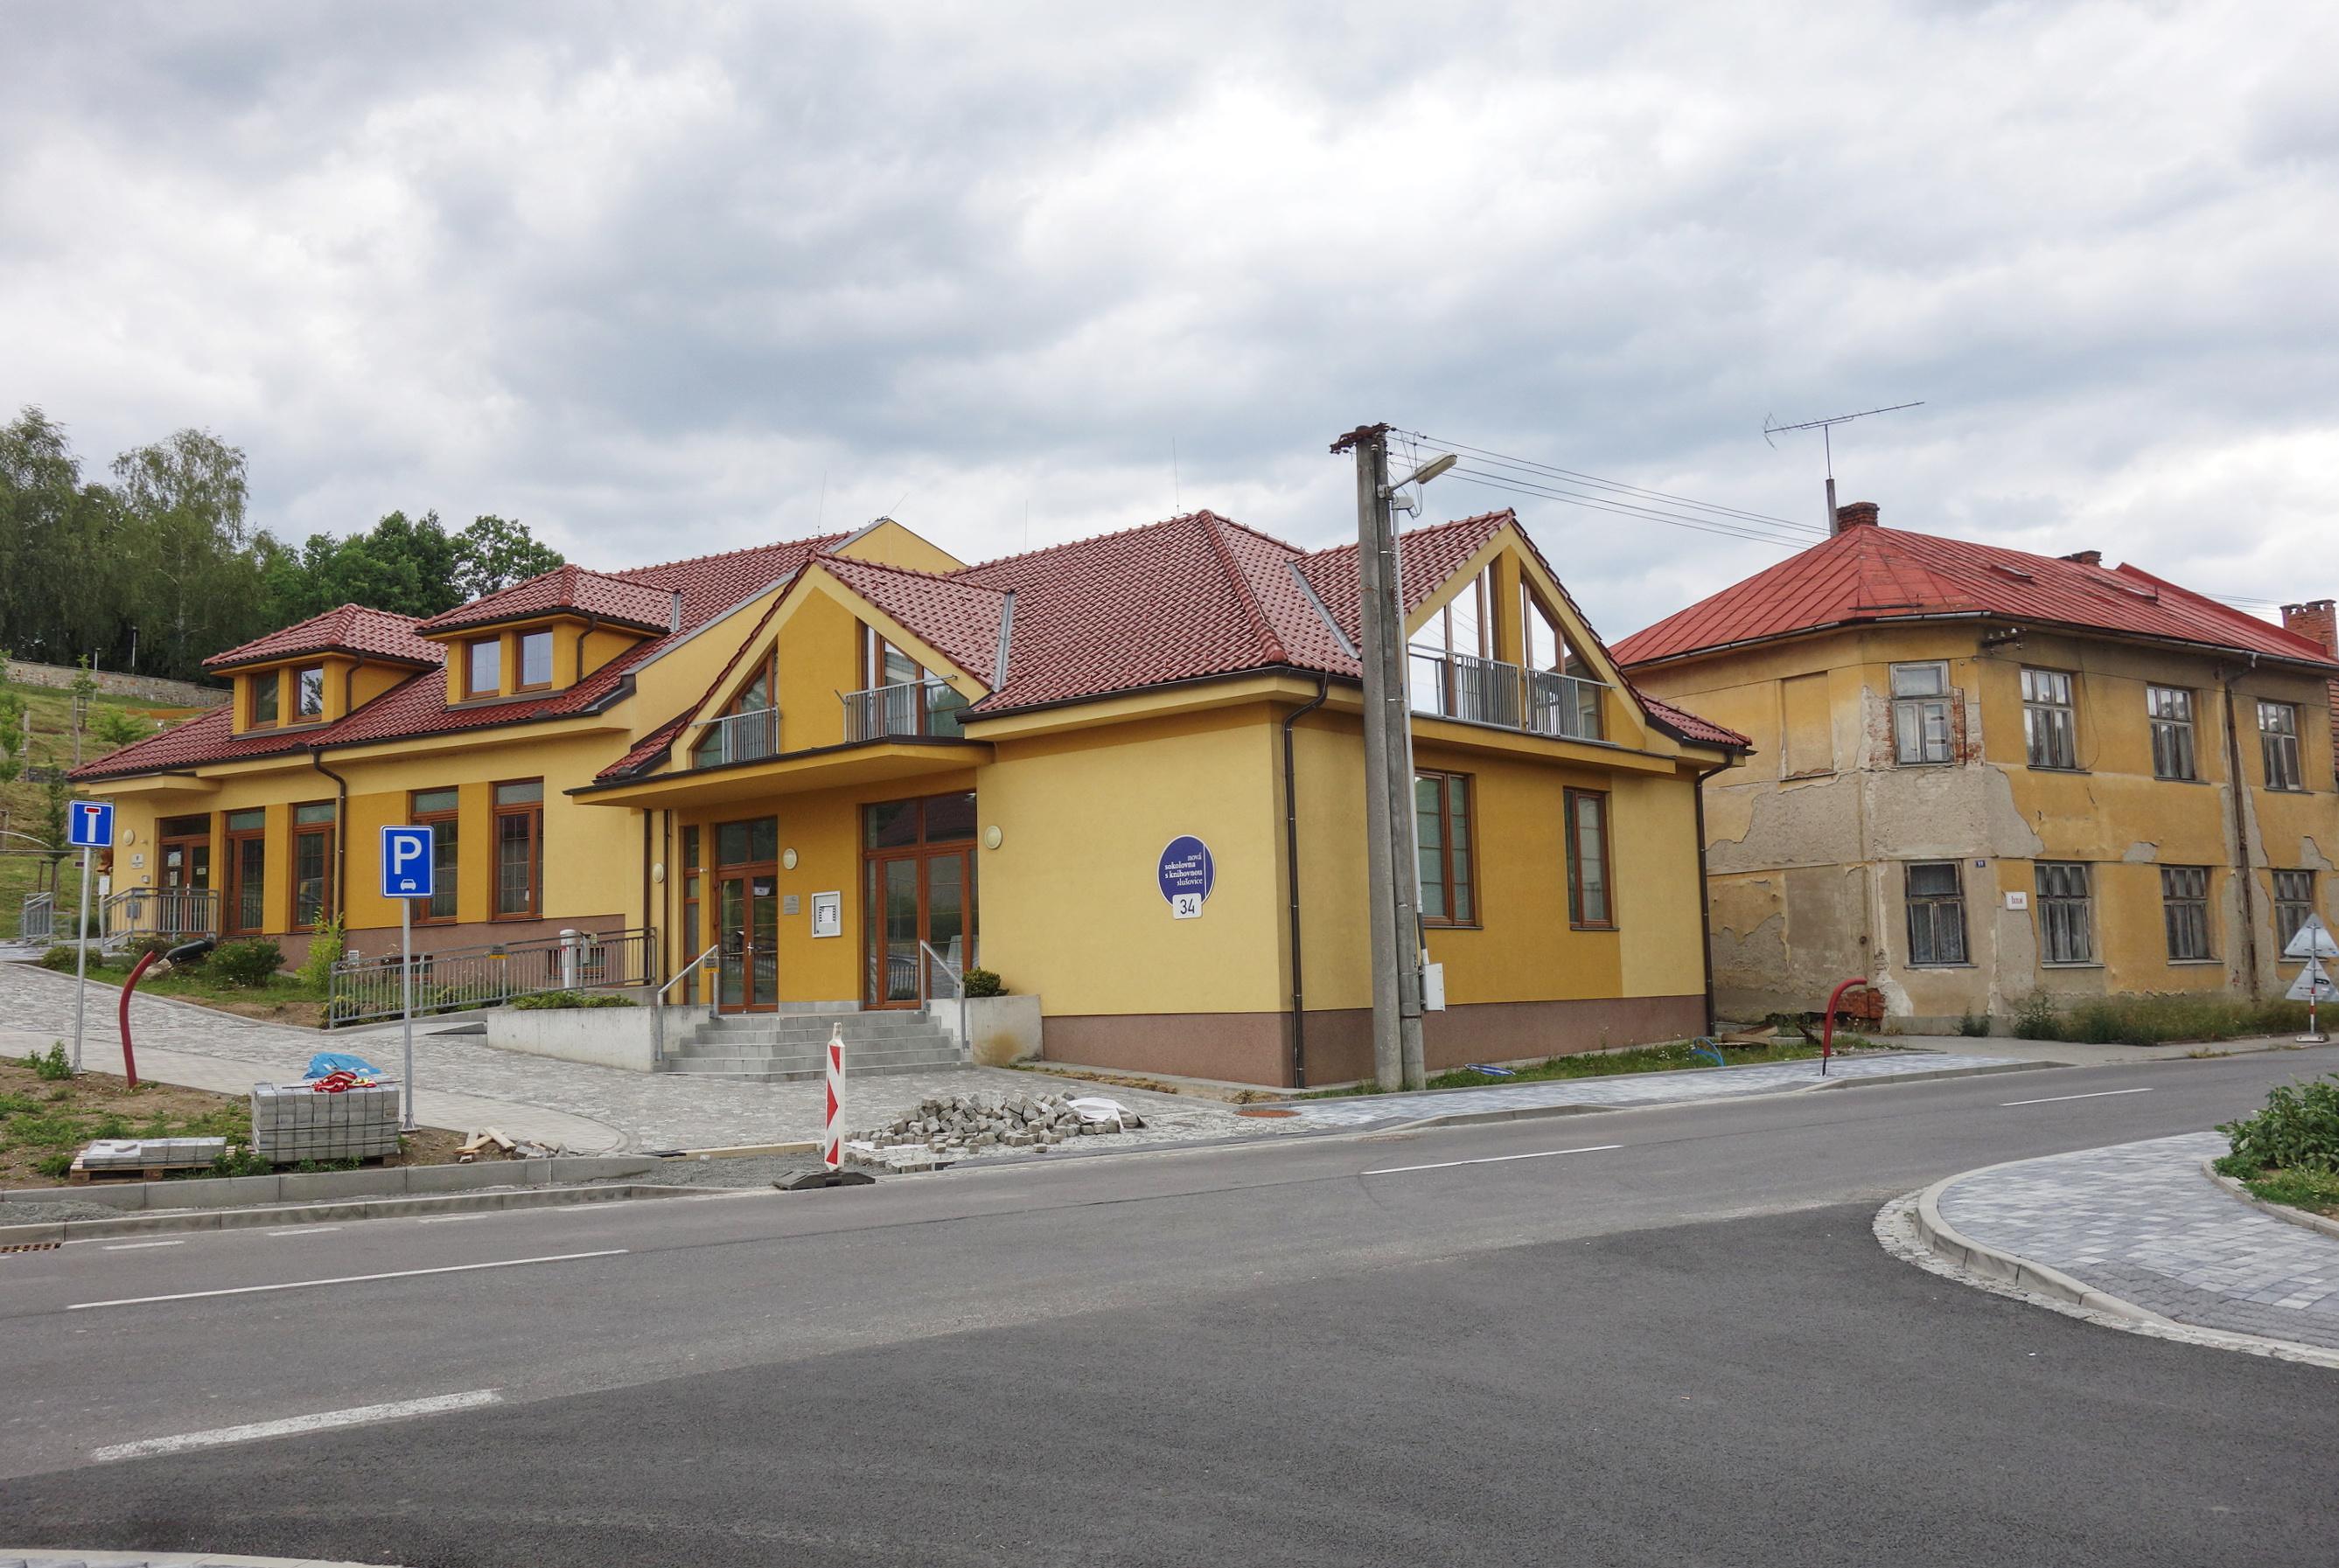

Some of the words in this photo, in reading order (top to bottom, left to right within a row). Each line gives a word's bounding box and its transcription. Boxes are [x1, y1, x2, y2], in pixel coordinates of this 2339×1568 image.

[394, 835, 422, 875] P
[1164, 861, 1196, 870] sokolovna
[1176, 877, 1203, 886] slušovice
[1180, 898, 1195, 915] 34
